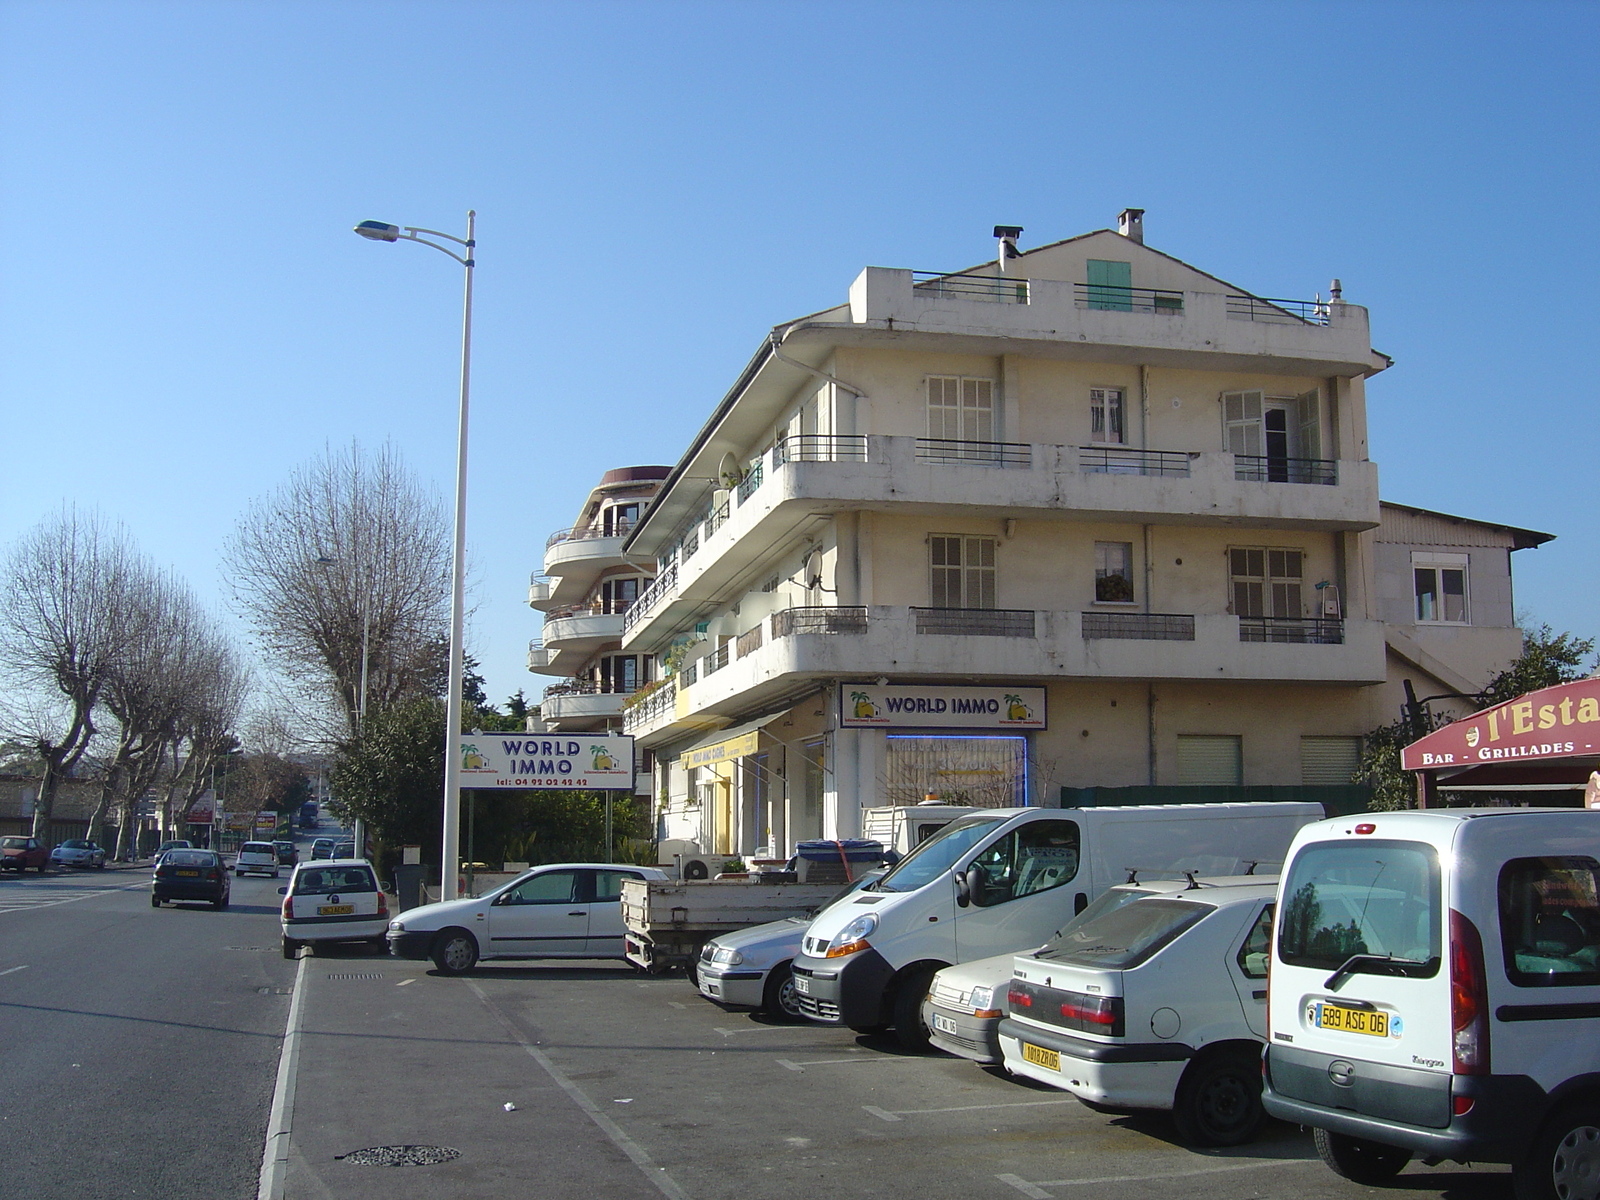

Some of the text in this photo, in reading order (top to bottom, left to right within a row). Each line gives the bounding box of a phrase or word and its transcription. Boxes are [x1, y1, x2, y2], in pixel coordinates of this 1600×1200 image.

[885, 697, 1000, 715] WORLD IMMO
[502, 740, 580, 756] WORLD
[1422, 752, 1454, 765] BAR
[1478, 741, 1574, 760] GRILLADES
[510, 759, 573, 775] IMMO
[1323, 1007, 1384, 1033] 589 ASG 06
